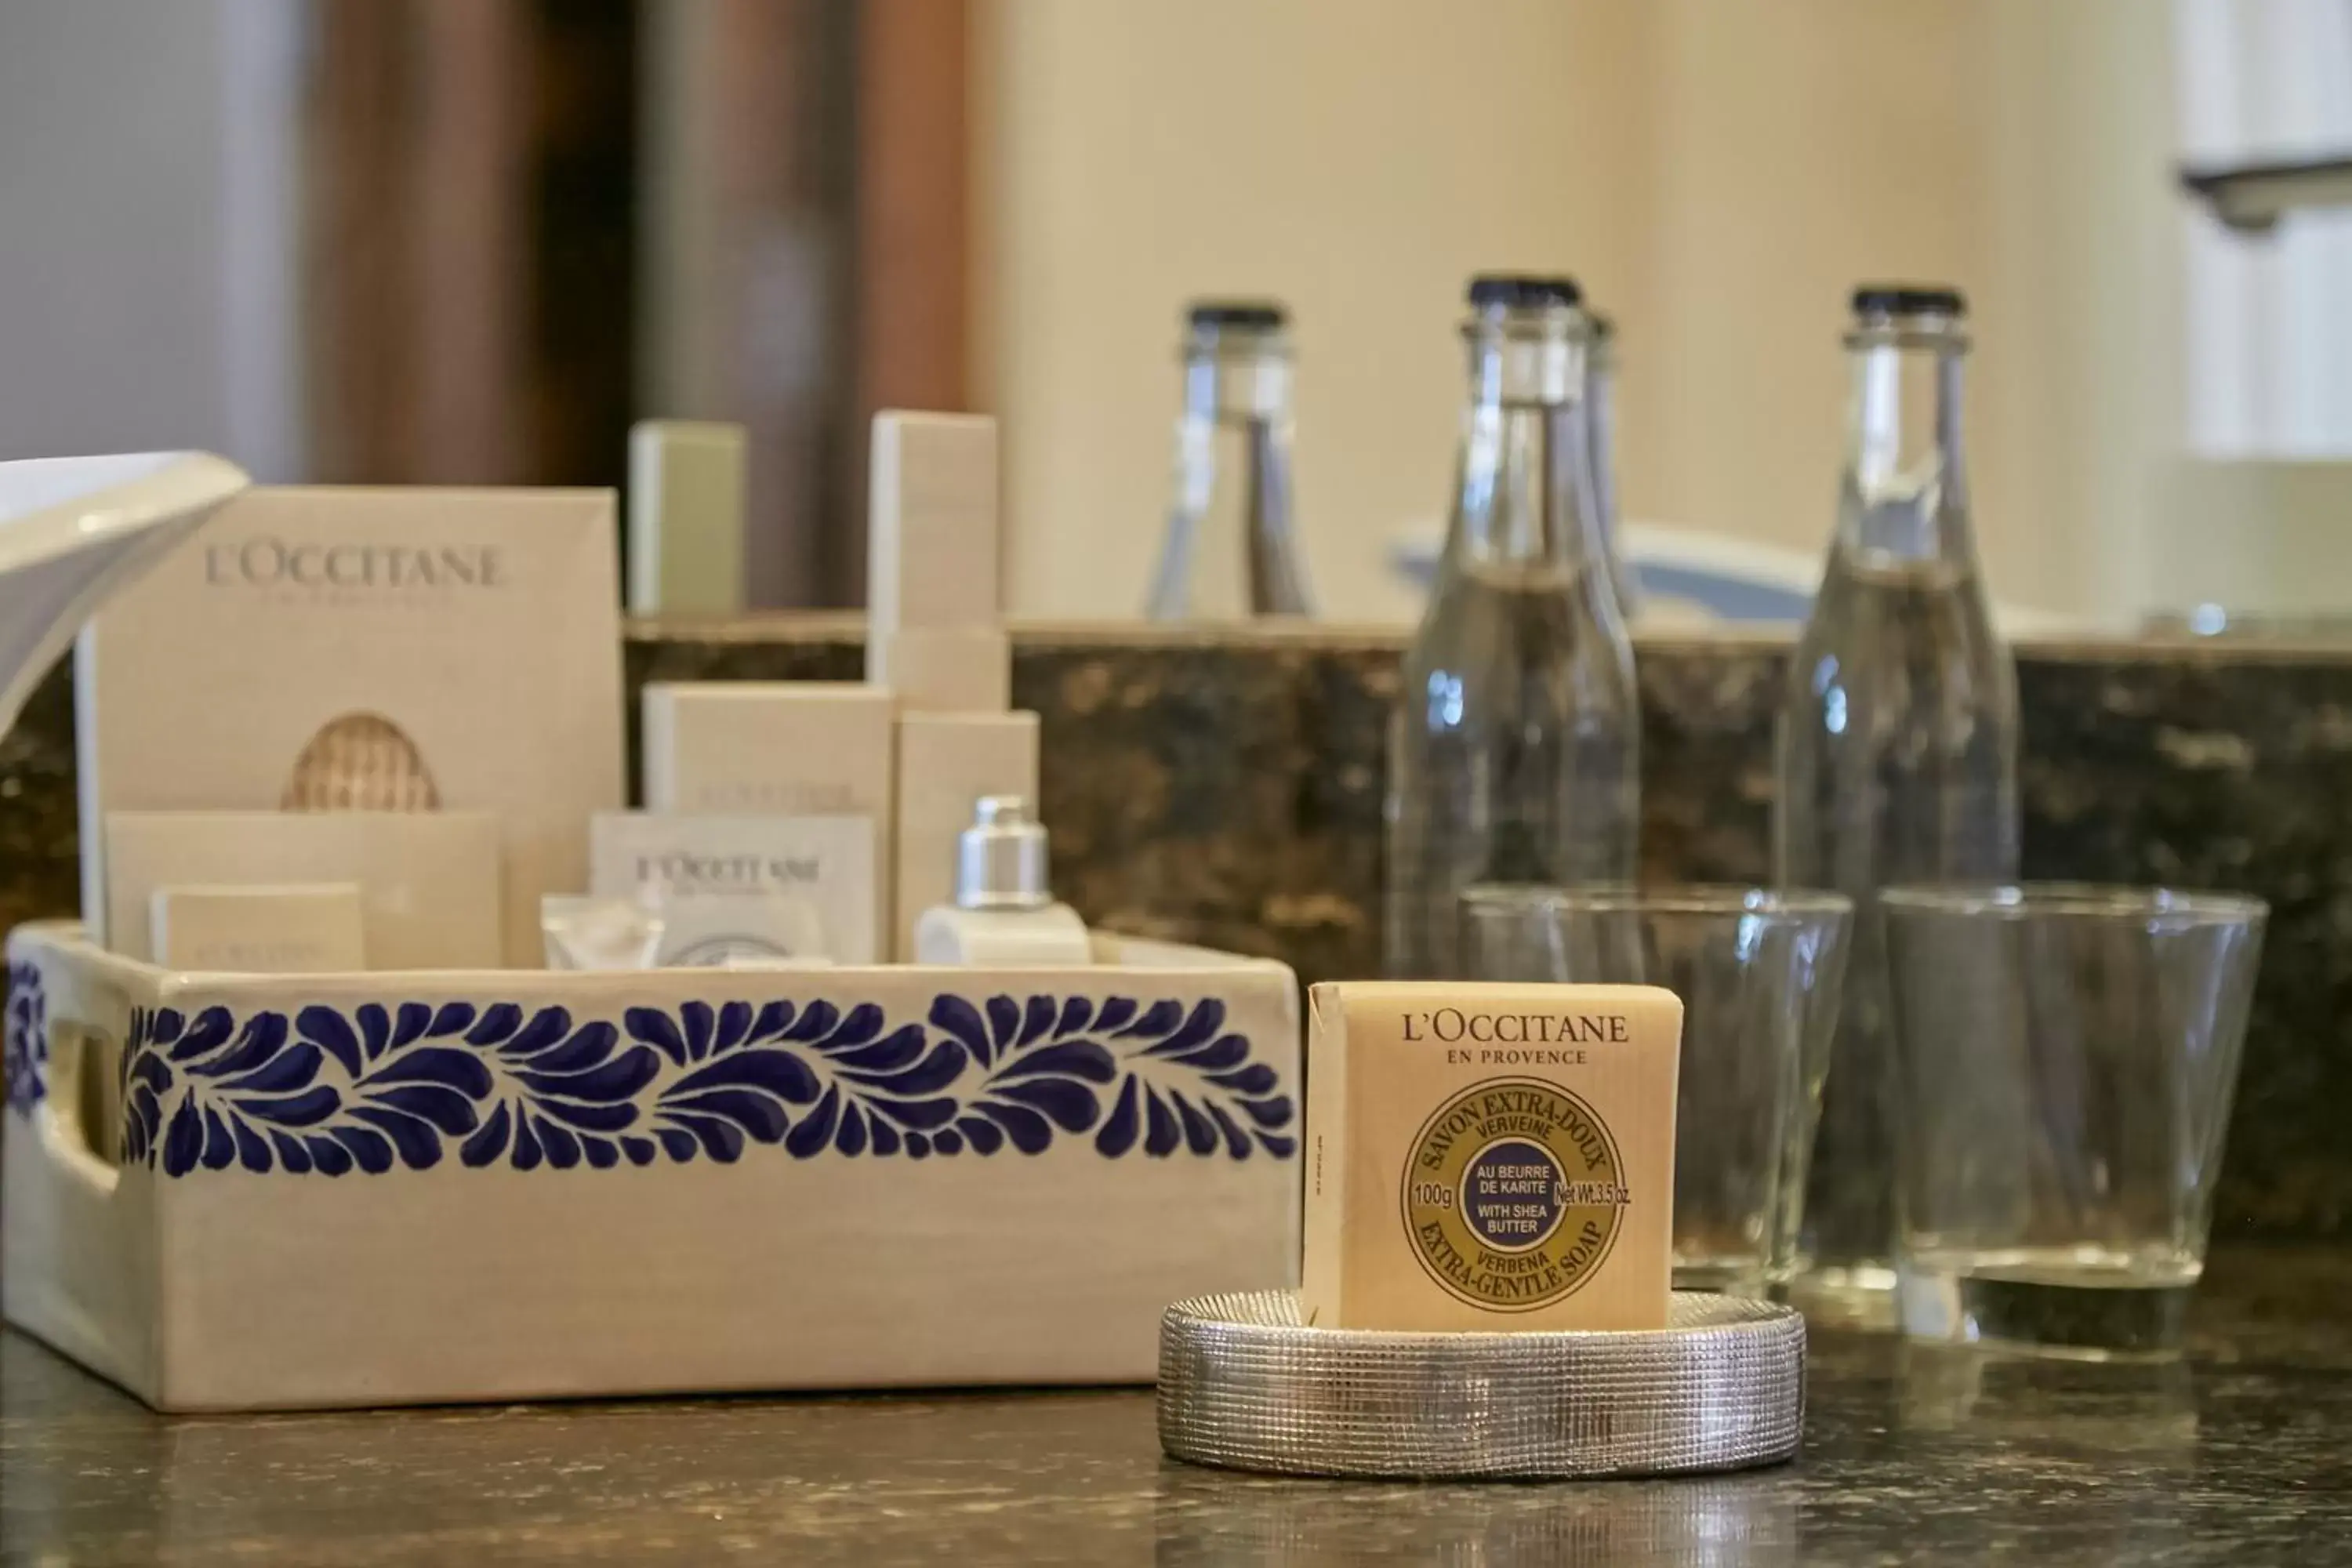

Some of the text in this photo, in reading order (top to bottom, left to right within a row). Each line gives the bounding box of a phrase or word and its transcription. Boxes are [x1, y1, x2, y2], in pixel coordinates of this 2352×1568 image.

[1402, 1007, 1629, 1043] L'OCCITANE
[1448, 1050, 1587, 1065] EN PROVENCE
[1421, 1091, 1606, 1171] SAVON EXTRA-DOUX
[1475, 1116, 1555, 1141] VERVEINE
[1477, 1166, 1550, 1178] AU BEURRE
[1415, 1183, 1452, 1210] 100g
[1480, 1181, 1498, 1194] DE
[1478, 1204, 1547, 1218] WITH SHEA
[1487, 1220, 1537, 1233] BUTTER
[1421, 1220, 1602, 1298] EXTRA-GENTLE SOAP
[1477, 1251, 1550, 1273] VERBENA
